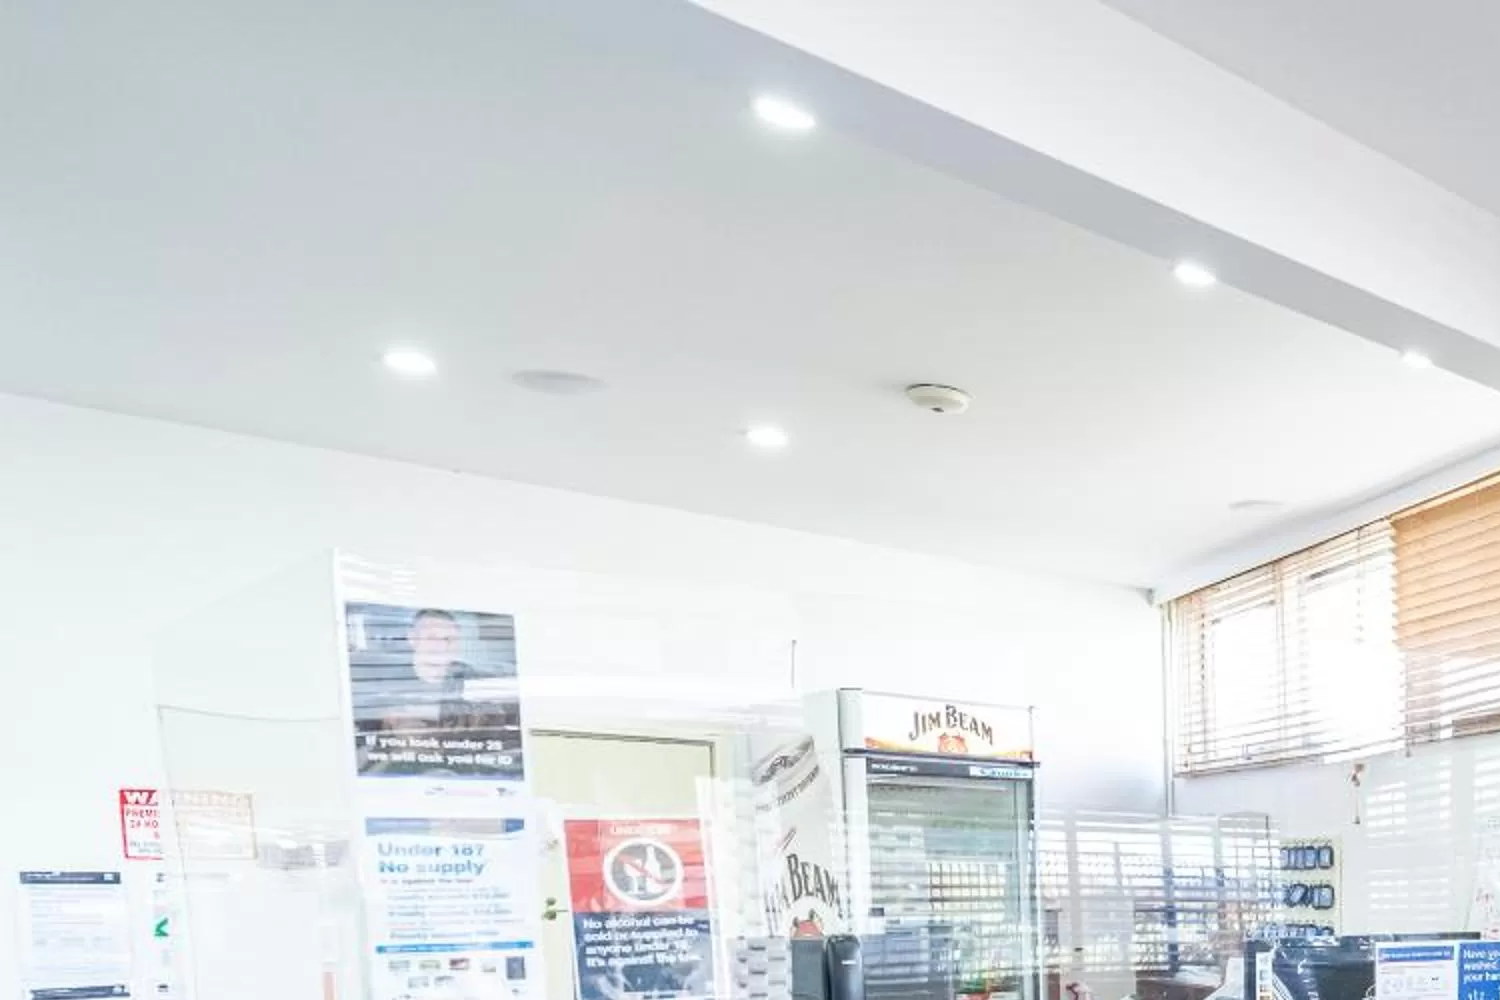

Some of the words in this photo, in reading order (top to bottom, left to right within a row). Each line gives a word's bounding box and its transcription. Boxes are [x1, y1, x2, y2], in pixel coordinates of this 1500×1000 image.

[908, 711, 942, 742] JIM
[945, 703, 994, 746] BEAM
[379, 737, 407, 749] you
[408, 736, 441, 748] look
[442, 739, 485, 750] under
[389, 751, 417, 762] will
[417, 752, 445, 763] ask
[446, 755, 474, 765] you
[377, 842, 443, 857] Under
[379, 860, 410, 873] No
[416, 859, 486, 876] supply
[583, 918, 602, 930] No
[604, 917, 651, 929] alcohol
[583, 931, 612, 943] sold
[585, 944, 633, 957] anyone
[1463, 949, 1485, 959] Have
[1463, 974, 1483, 984] your
